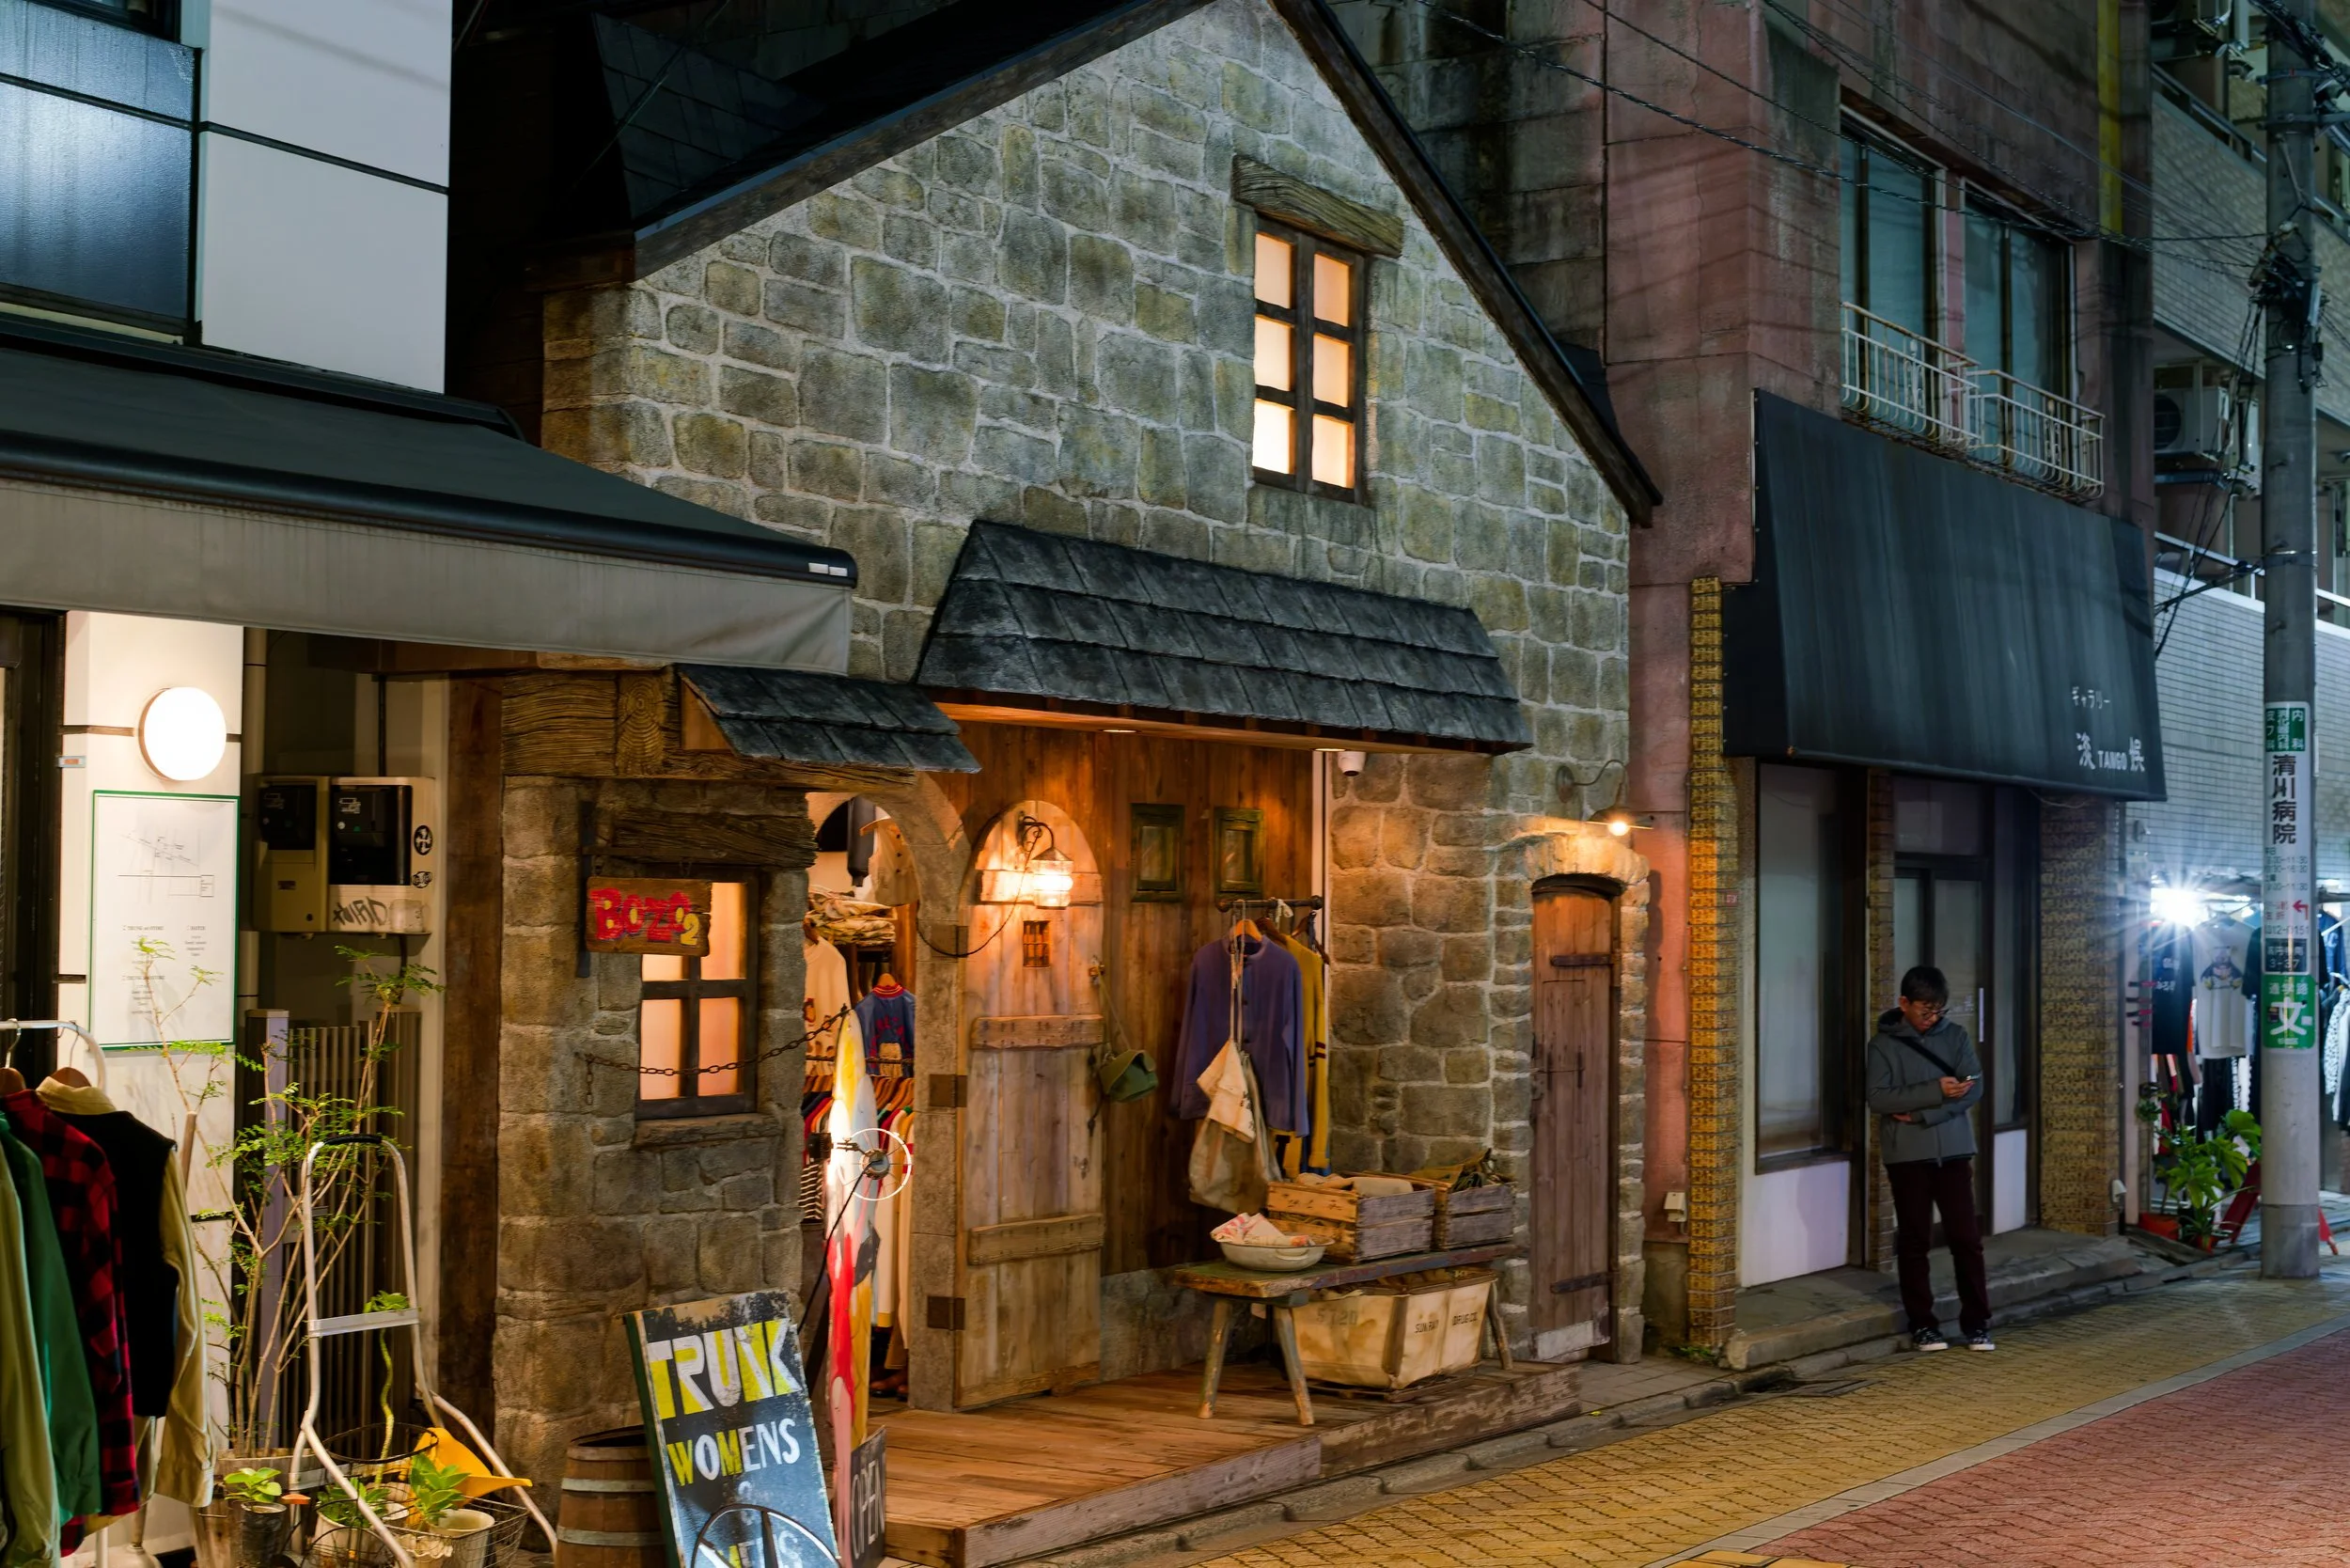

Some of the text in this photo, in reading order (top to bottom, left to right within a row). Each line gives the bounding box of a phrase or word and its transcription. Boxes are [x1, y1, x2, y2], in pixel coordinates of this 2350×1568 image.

[2292, 709, 2304, 750] 内科
[2097, 750, 2128, 770] TANGO
[2272, 754, 2296, 844] 清川病院
[2268, 981, 2309, 996] 通学路
[2269, 996, 2308, 1036] 文
[647, 1317, 803, 1420] TRUNK
[666, 1418, 801, 1487] WOMENS
[850, 1459, 885, 1560] OPEN
